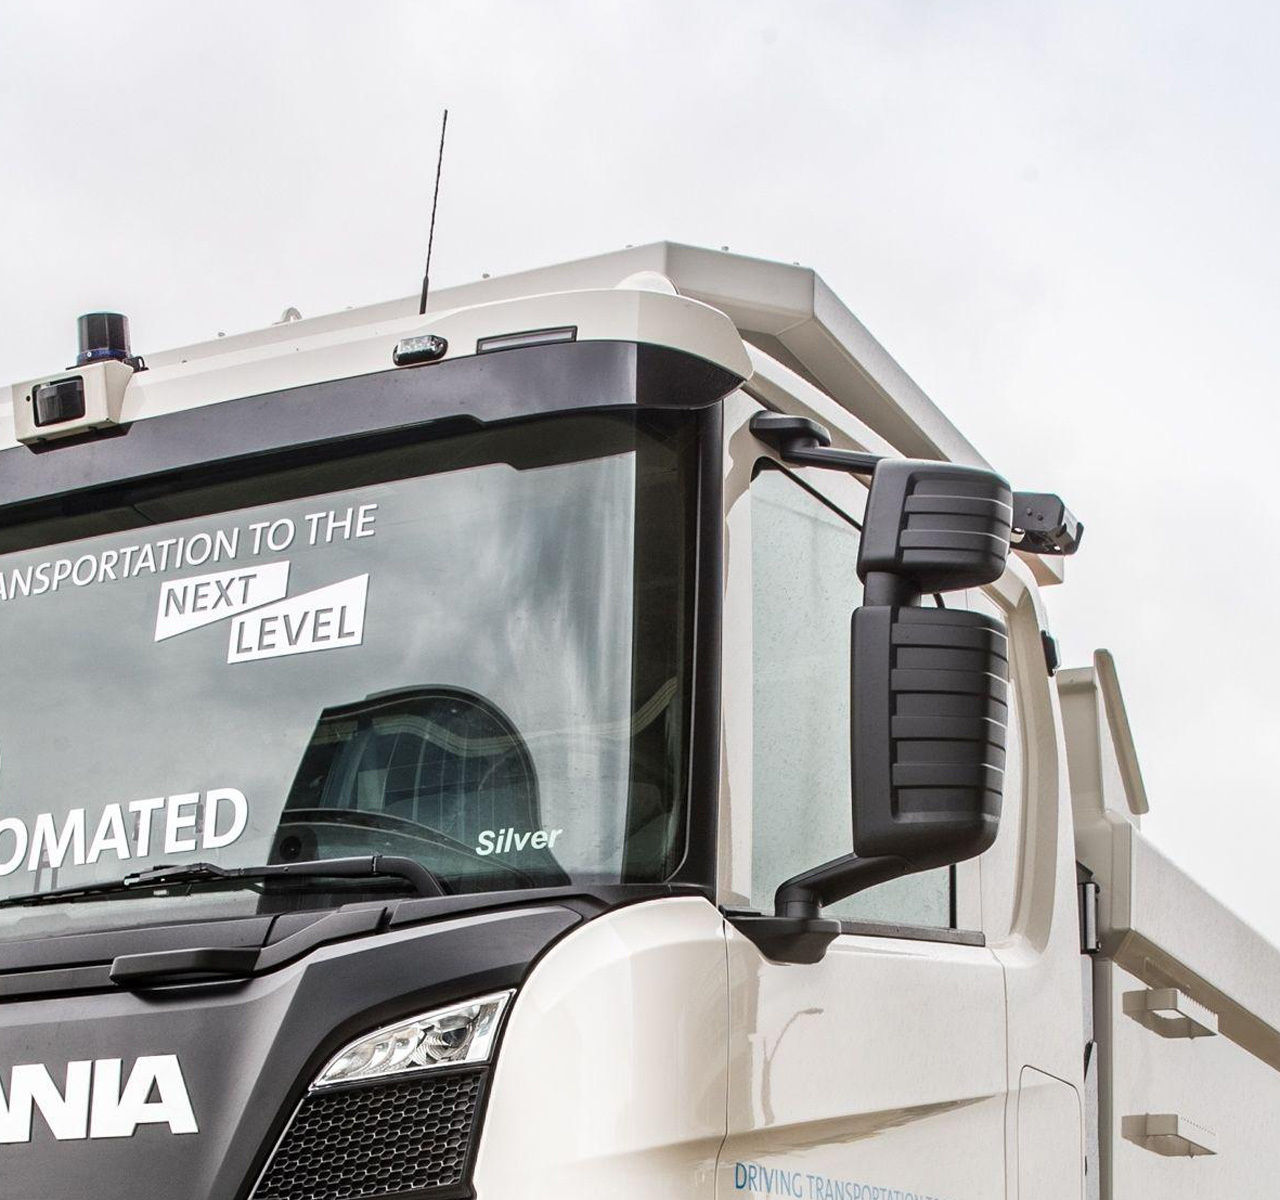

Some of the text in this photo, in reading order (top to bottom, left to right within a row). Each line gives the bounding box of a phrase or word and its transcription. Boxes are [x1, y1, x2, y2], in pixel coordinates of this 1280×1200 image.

[249, 517, 296, 555] TO
[305, 503, 378, 545] THE
[163, 573, 257, 618] NEXT
[235, 605, 357, 655] LEVEL
[475, 827, 563, 856] Silver
[734, 1162, 803, 1198] DRIVING
